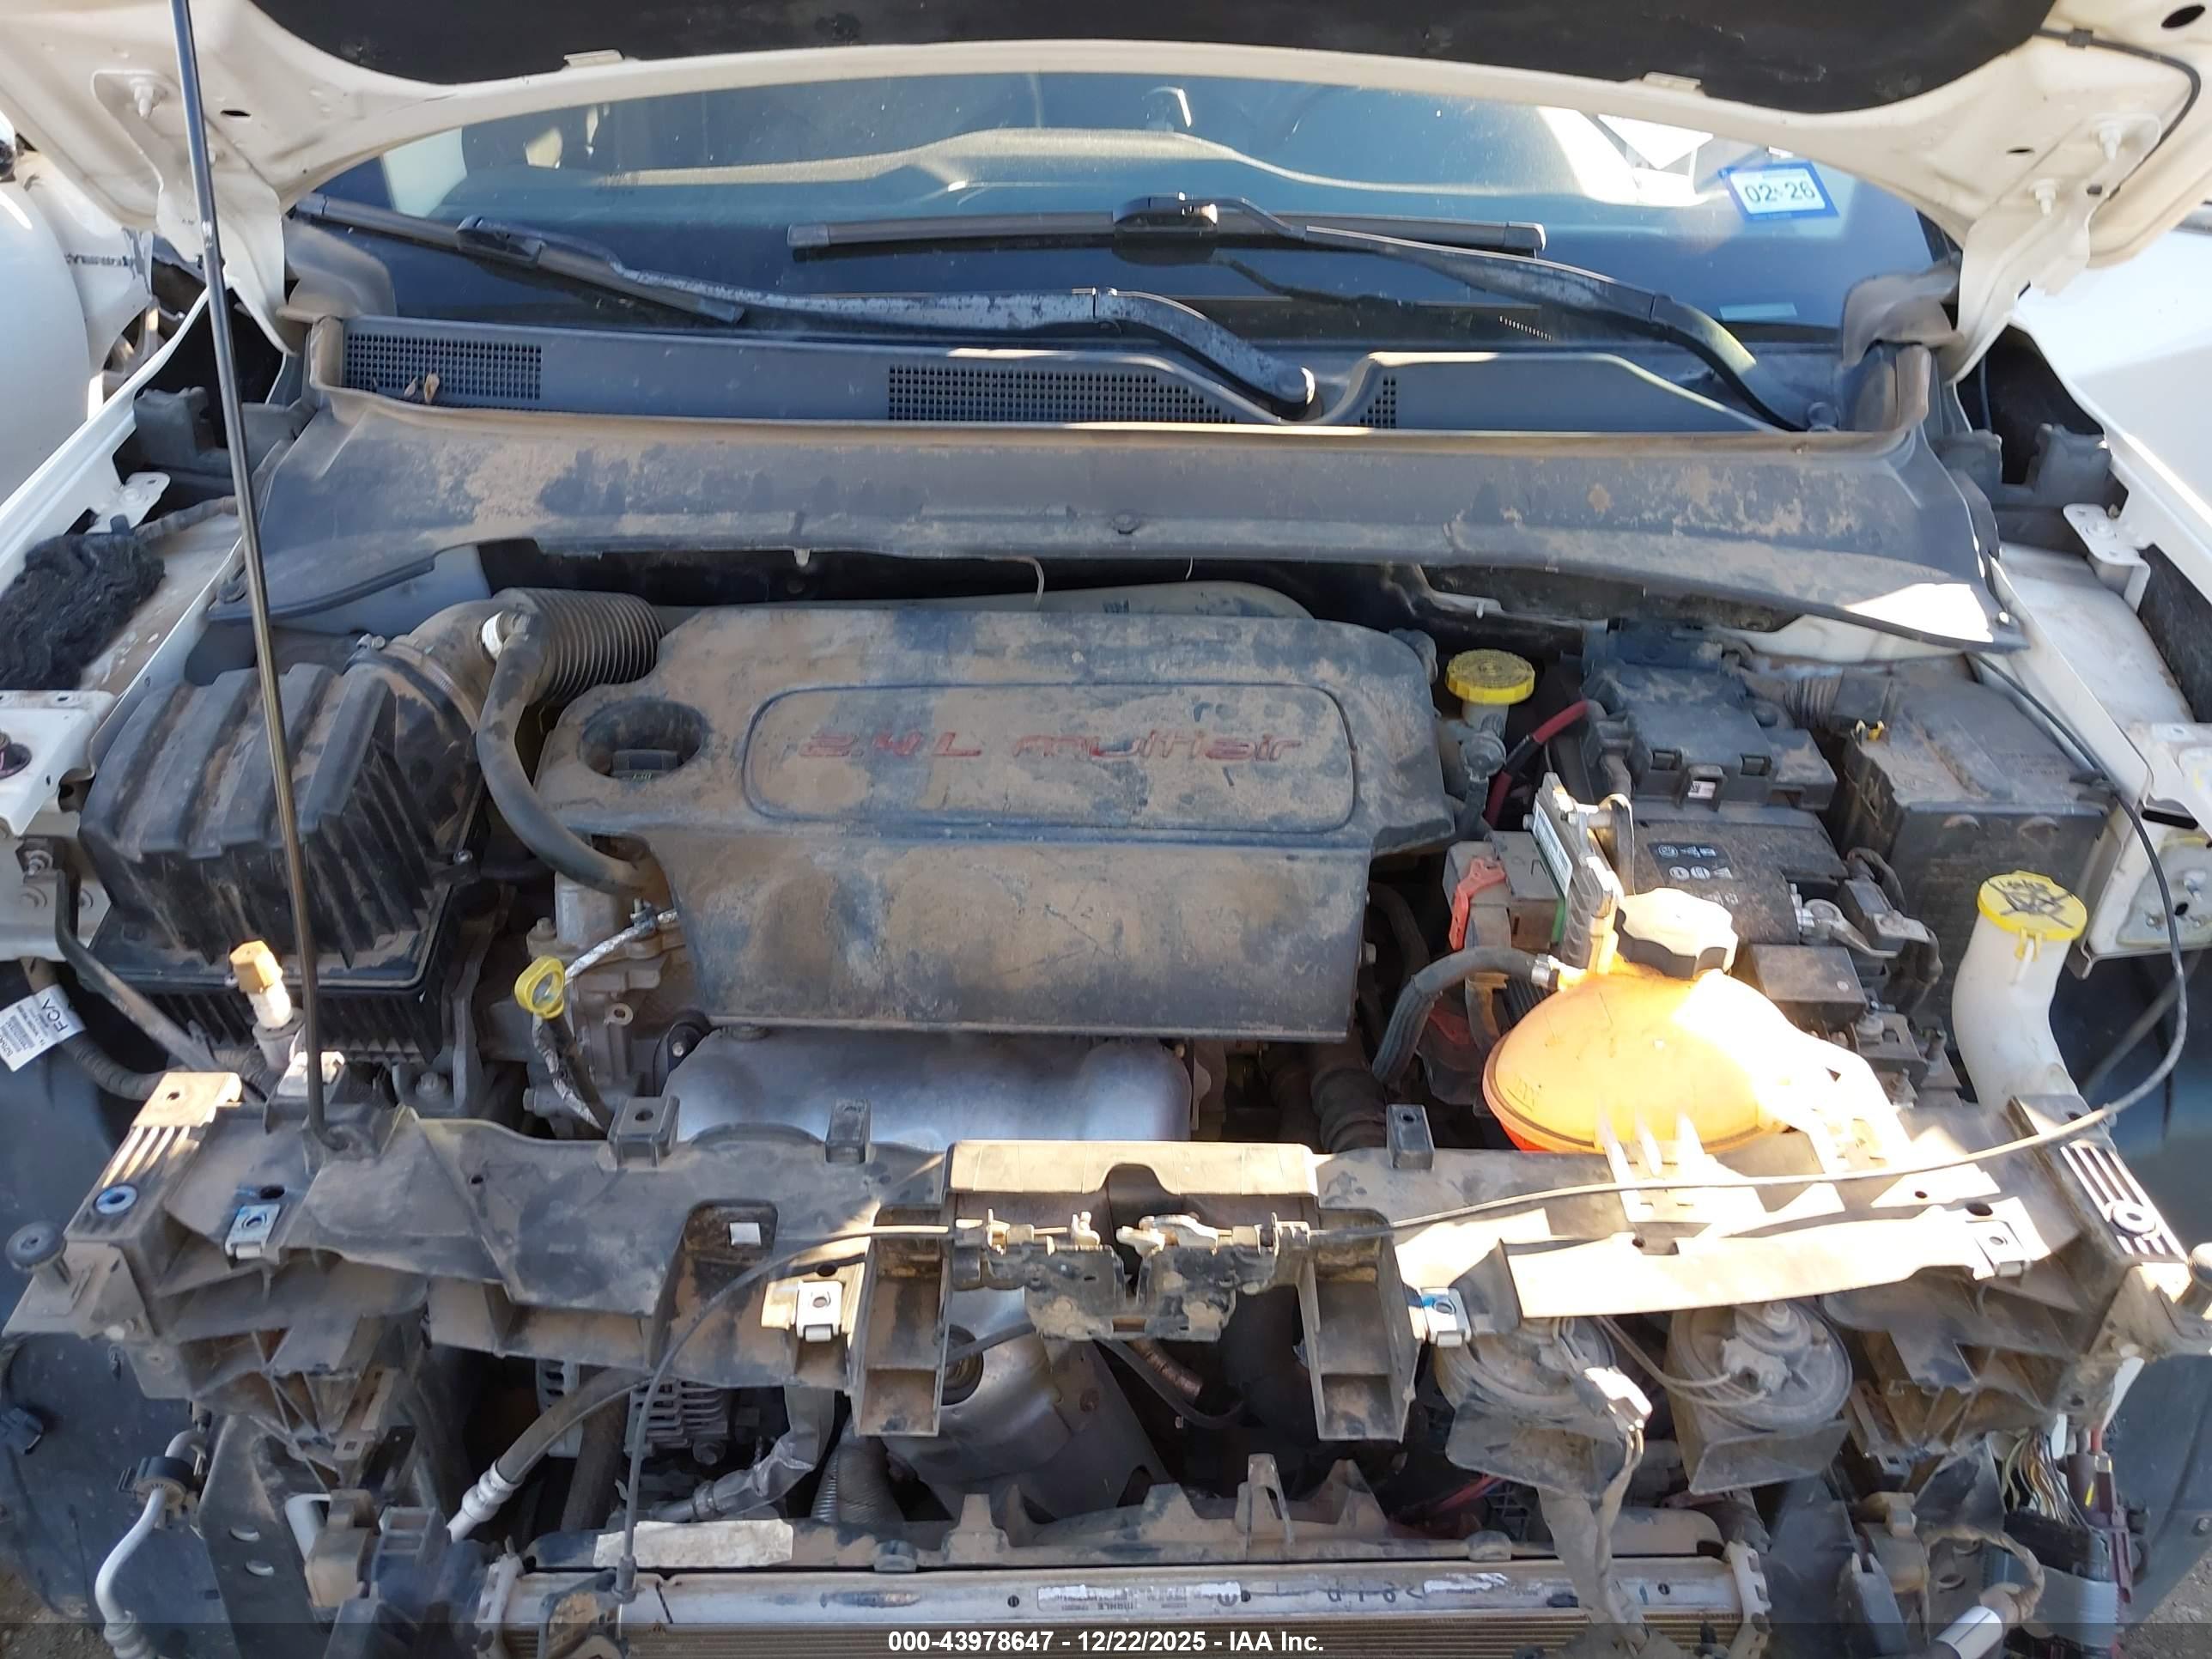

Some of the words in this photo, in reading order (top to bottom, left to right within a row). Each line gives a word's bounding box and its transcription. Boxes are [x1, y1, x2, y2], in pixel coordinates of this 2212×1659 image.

[1744, 184, 1778, 204] 02
[1784, 179, 1816, 200] 26
[41, 998, 69, 1033] FCA
